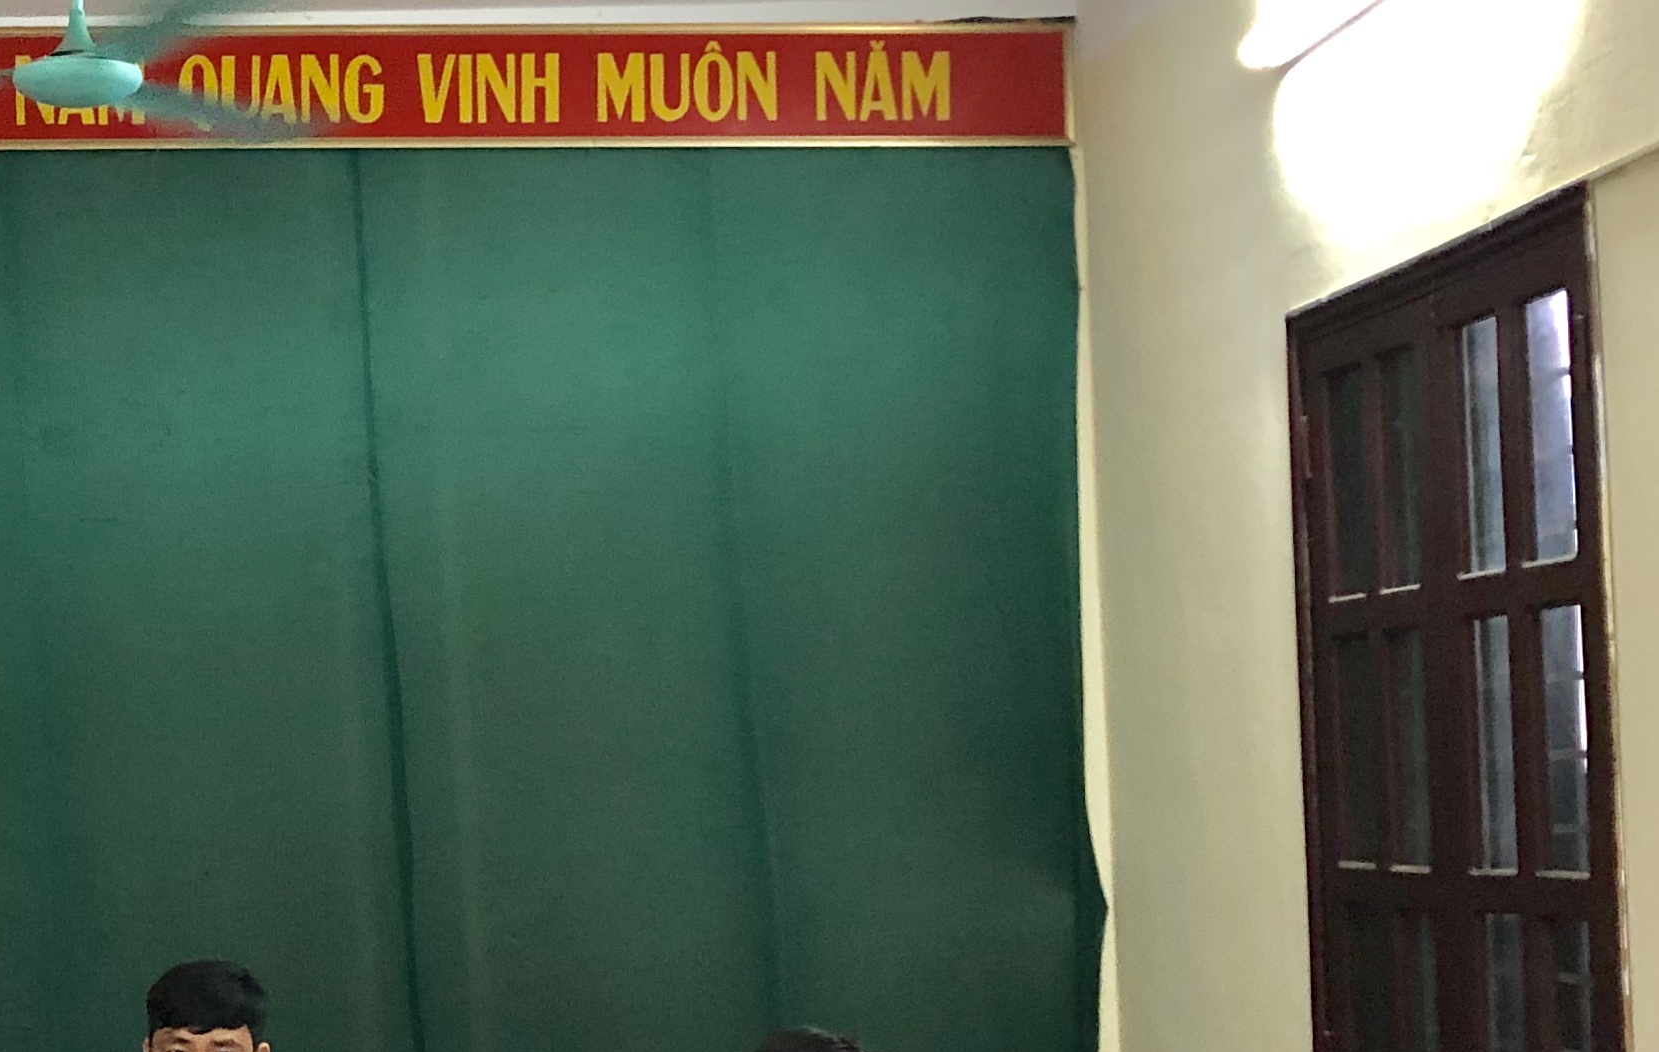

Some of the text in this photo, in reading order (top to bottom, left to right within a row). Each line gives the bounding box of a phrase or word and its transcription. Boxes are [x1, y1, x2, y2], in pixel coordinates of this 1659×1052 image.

[417, 53, 560, 124] VINH
[596, 40, 778, 123] MUÔN
[815, 40, 951, 122] NĂM
